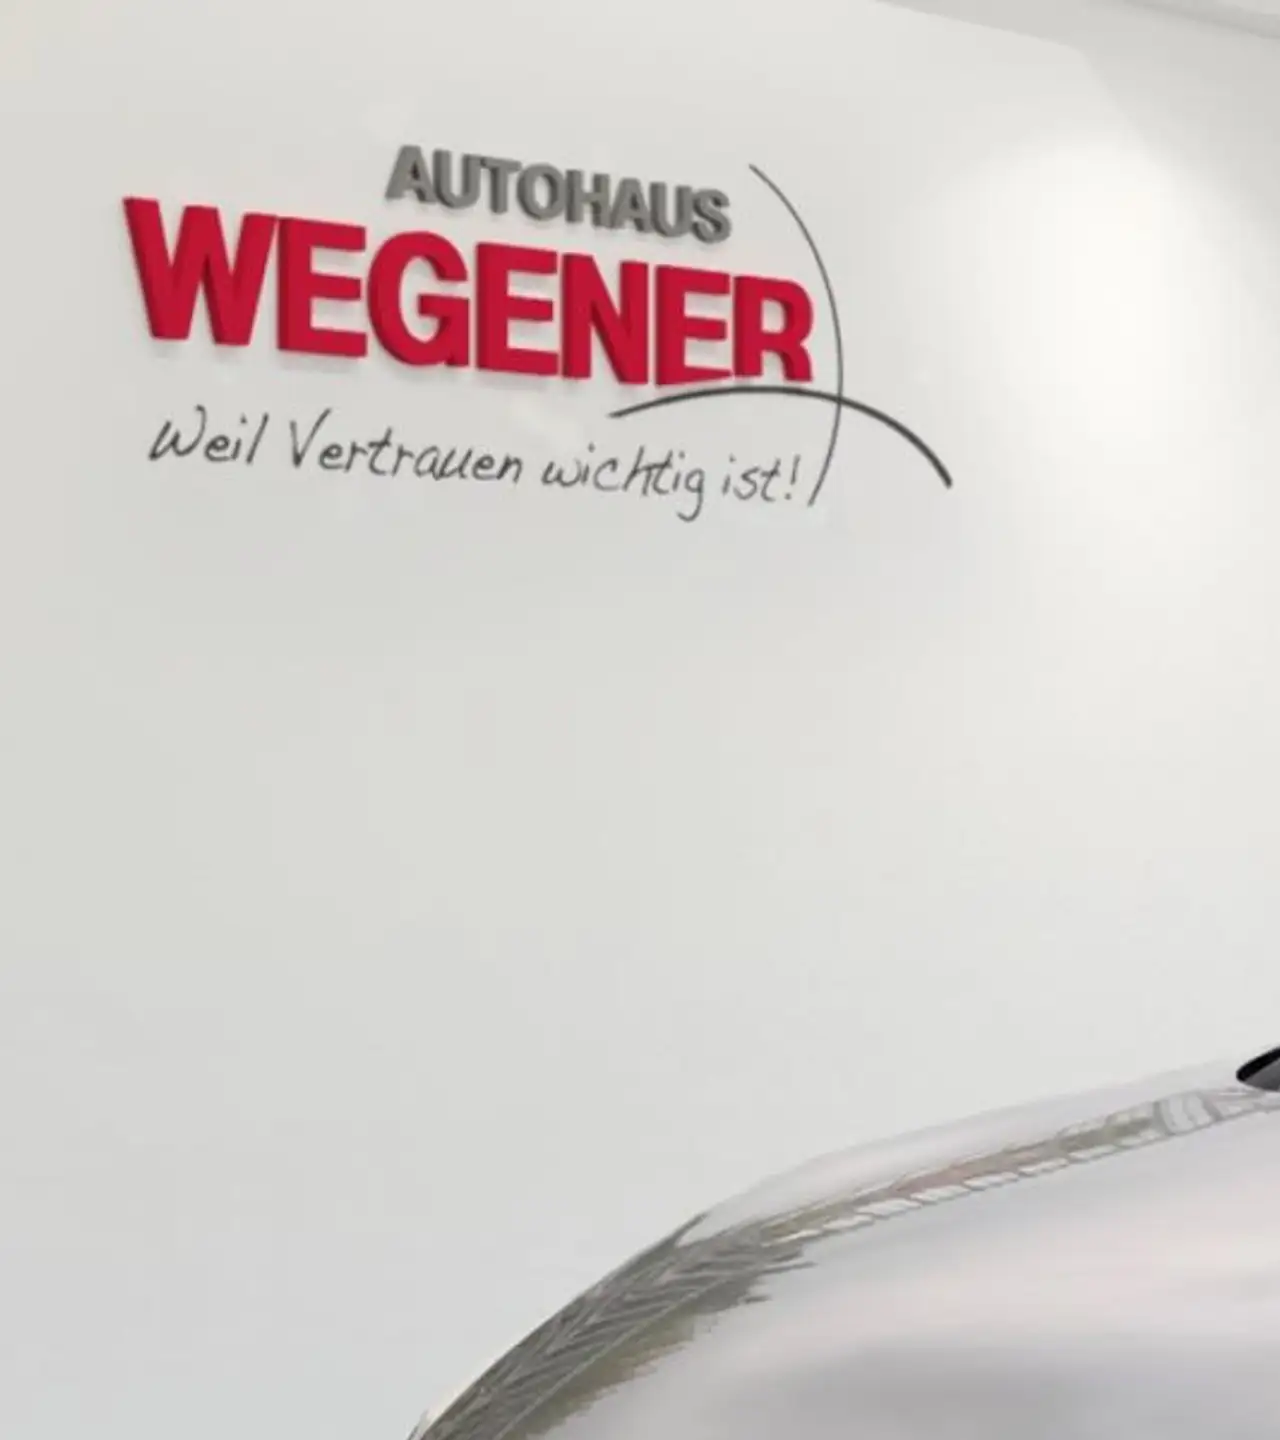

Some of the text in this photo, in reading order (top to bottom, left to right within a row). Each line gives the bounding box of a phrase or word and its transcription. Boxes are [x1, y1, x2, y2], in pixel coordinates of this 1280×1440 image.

[384, 145, 732, 244] AUTOHAUS
[122, 196, 814, 387] WEGENER
[148, 404, 803, 523] Weil Vertrauen wichtig ist!
